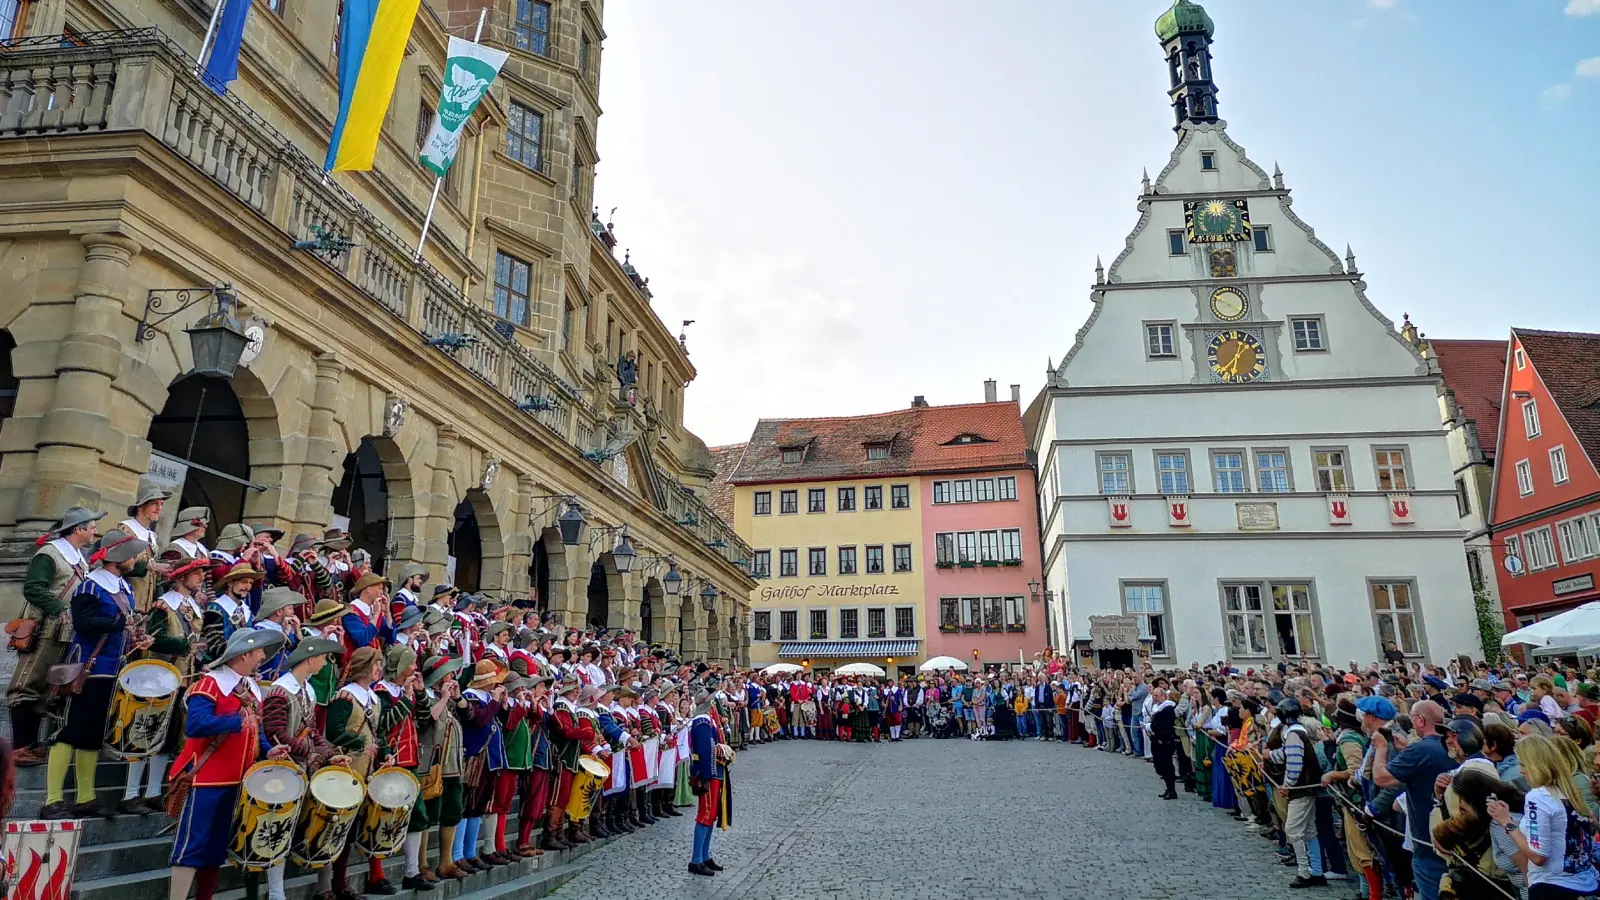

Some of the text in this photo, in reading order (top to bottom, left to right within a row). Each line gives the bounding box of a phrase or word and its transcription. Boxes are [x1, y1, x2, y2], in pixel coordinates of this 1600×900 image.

[760, 584, 899, 602] Gasthof Marktplatz
[1103, 635, 1127, 643] KASSE
